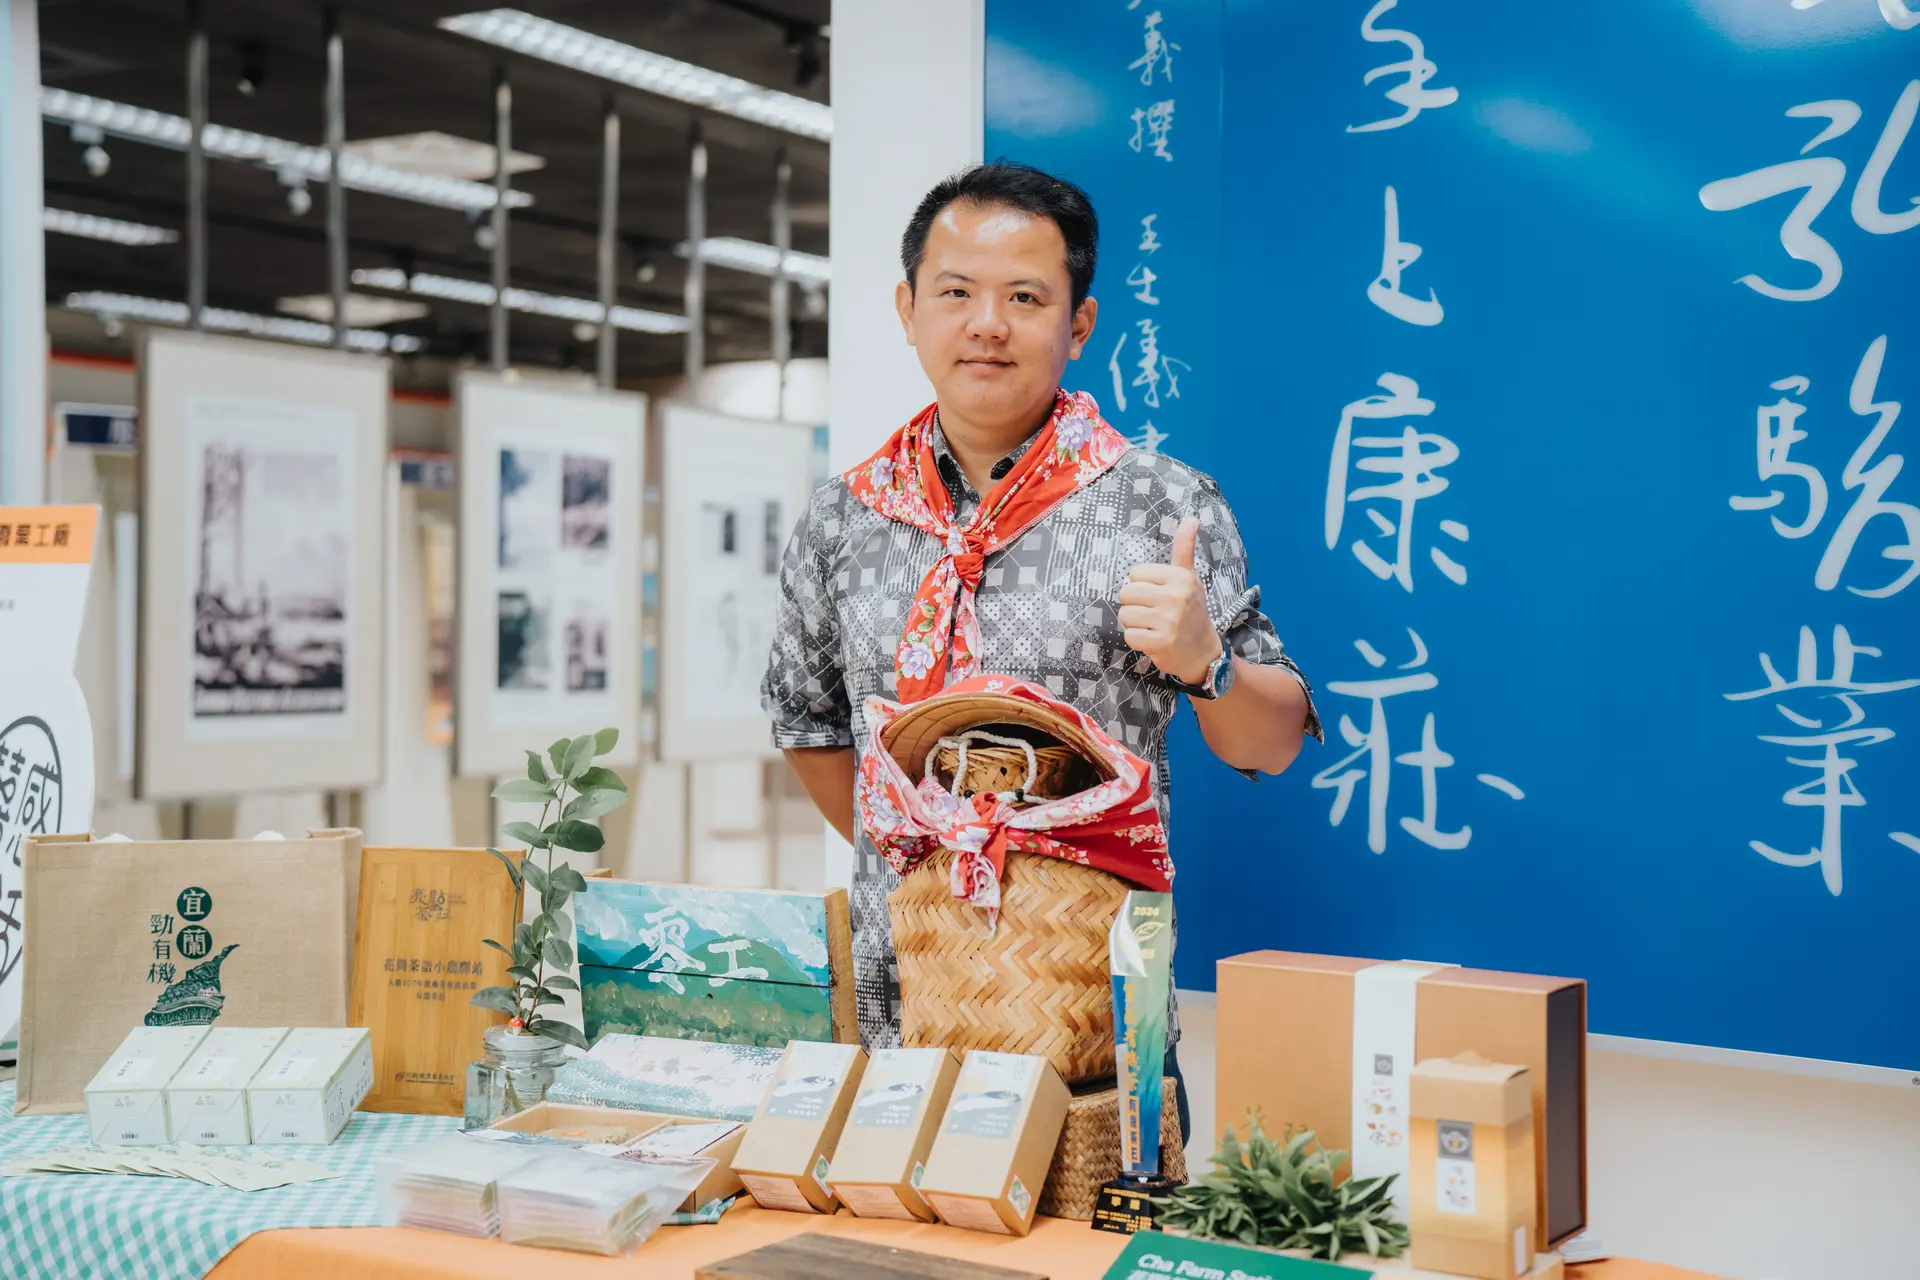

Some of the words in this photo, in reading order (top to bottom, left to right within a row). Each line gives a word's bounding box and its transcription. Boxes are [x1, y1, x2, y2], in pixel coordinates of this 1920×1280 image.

[1127, 0, 1181, 162] 義撰
[146, 914, 176, 984] 勁有機
[179, 888, 209, 958] 宜蘭
[1138, 1254, 1174, 1272] Cha
[1175, 1260, 1225, 1280] Farm
